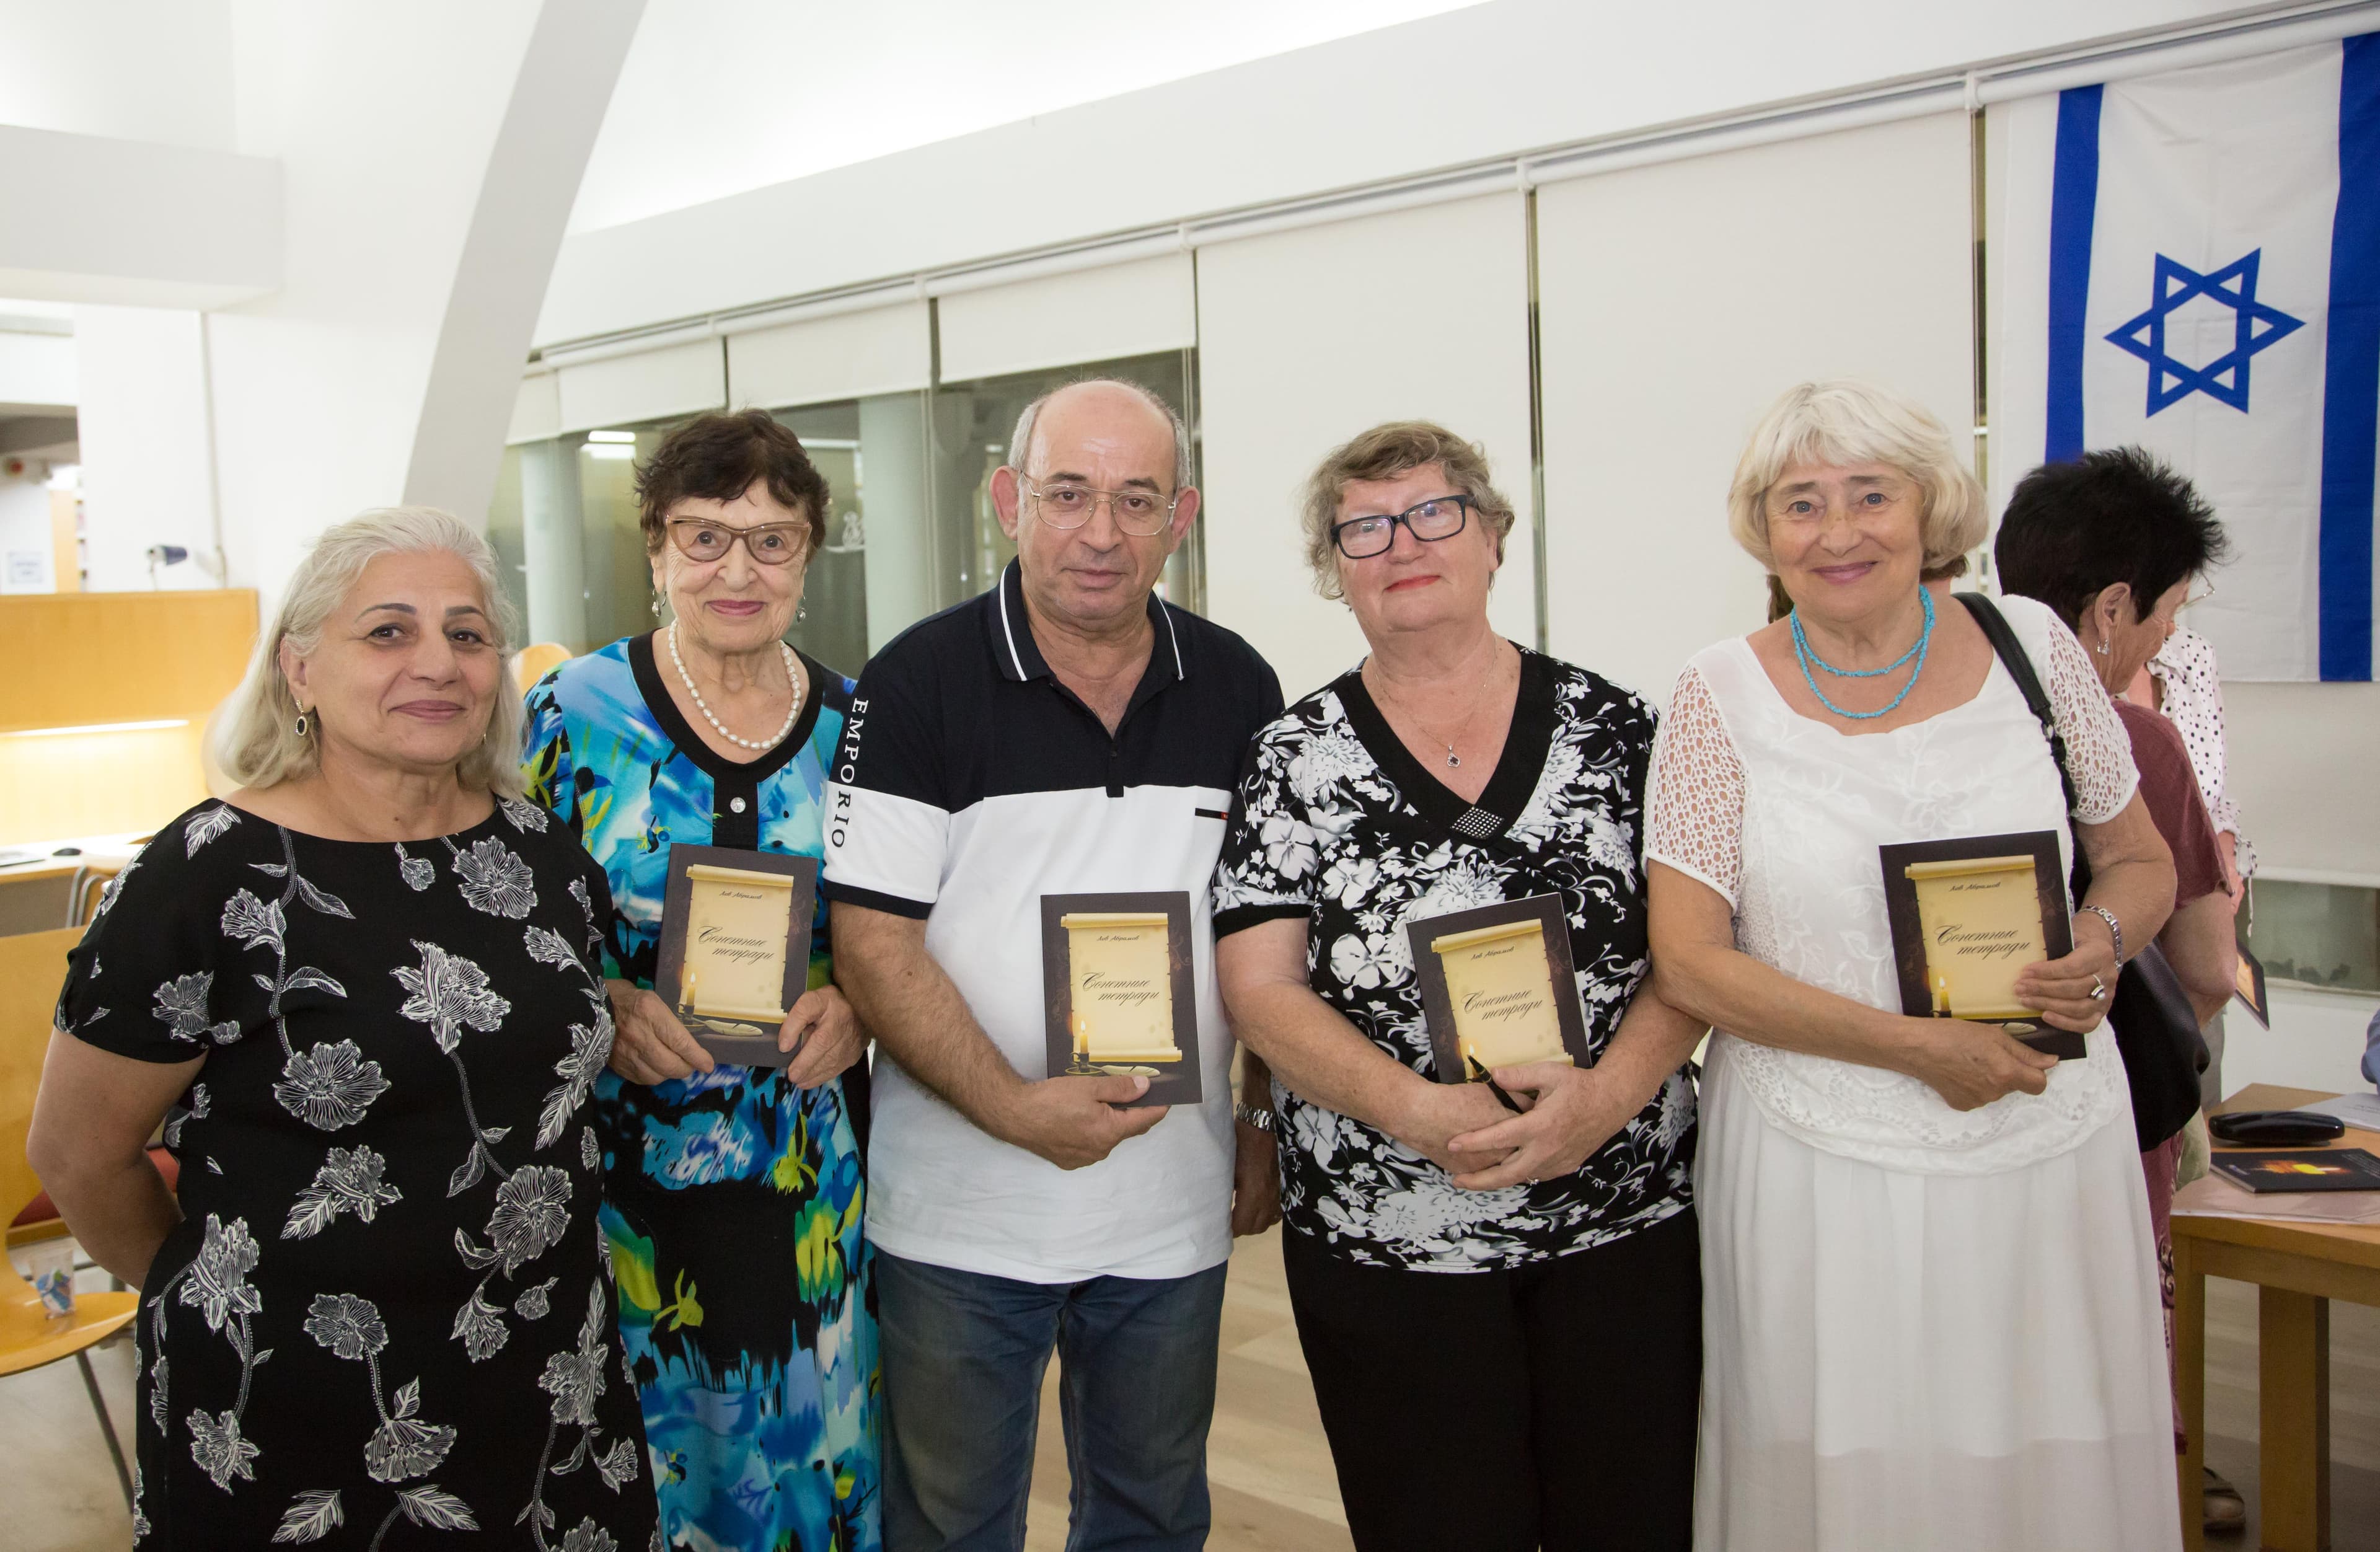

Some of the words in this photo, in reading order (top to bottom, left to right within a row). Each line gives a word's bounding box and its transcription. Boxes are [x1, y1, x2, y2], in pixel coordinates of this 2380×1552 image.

[831, 697, 869, 848] EMPORIO
[698, 925, 767, 948] Сонетные
[1934, 924, 2019, 946] Сонетные
[712, 946, 775, 965] тетради
[1957, 941, 2031, 960] тетради
[1080, 971, 1151, 991] Сонетные
[1098, 991, 1160, 1007] тетради
[1461, 989, 1532, 1014] Сонетные
[1481, 999, 1543, 1021] тетради
